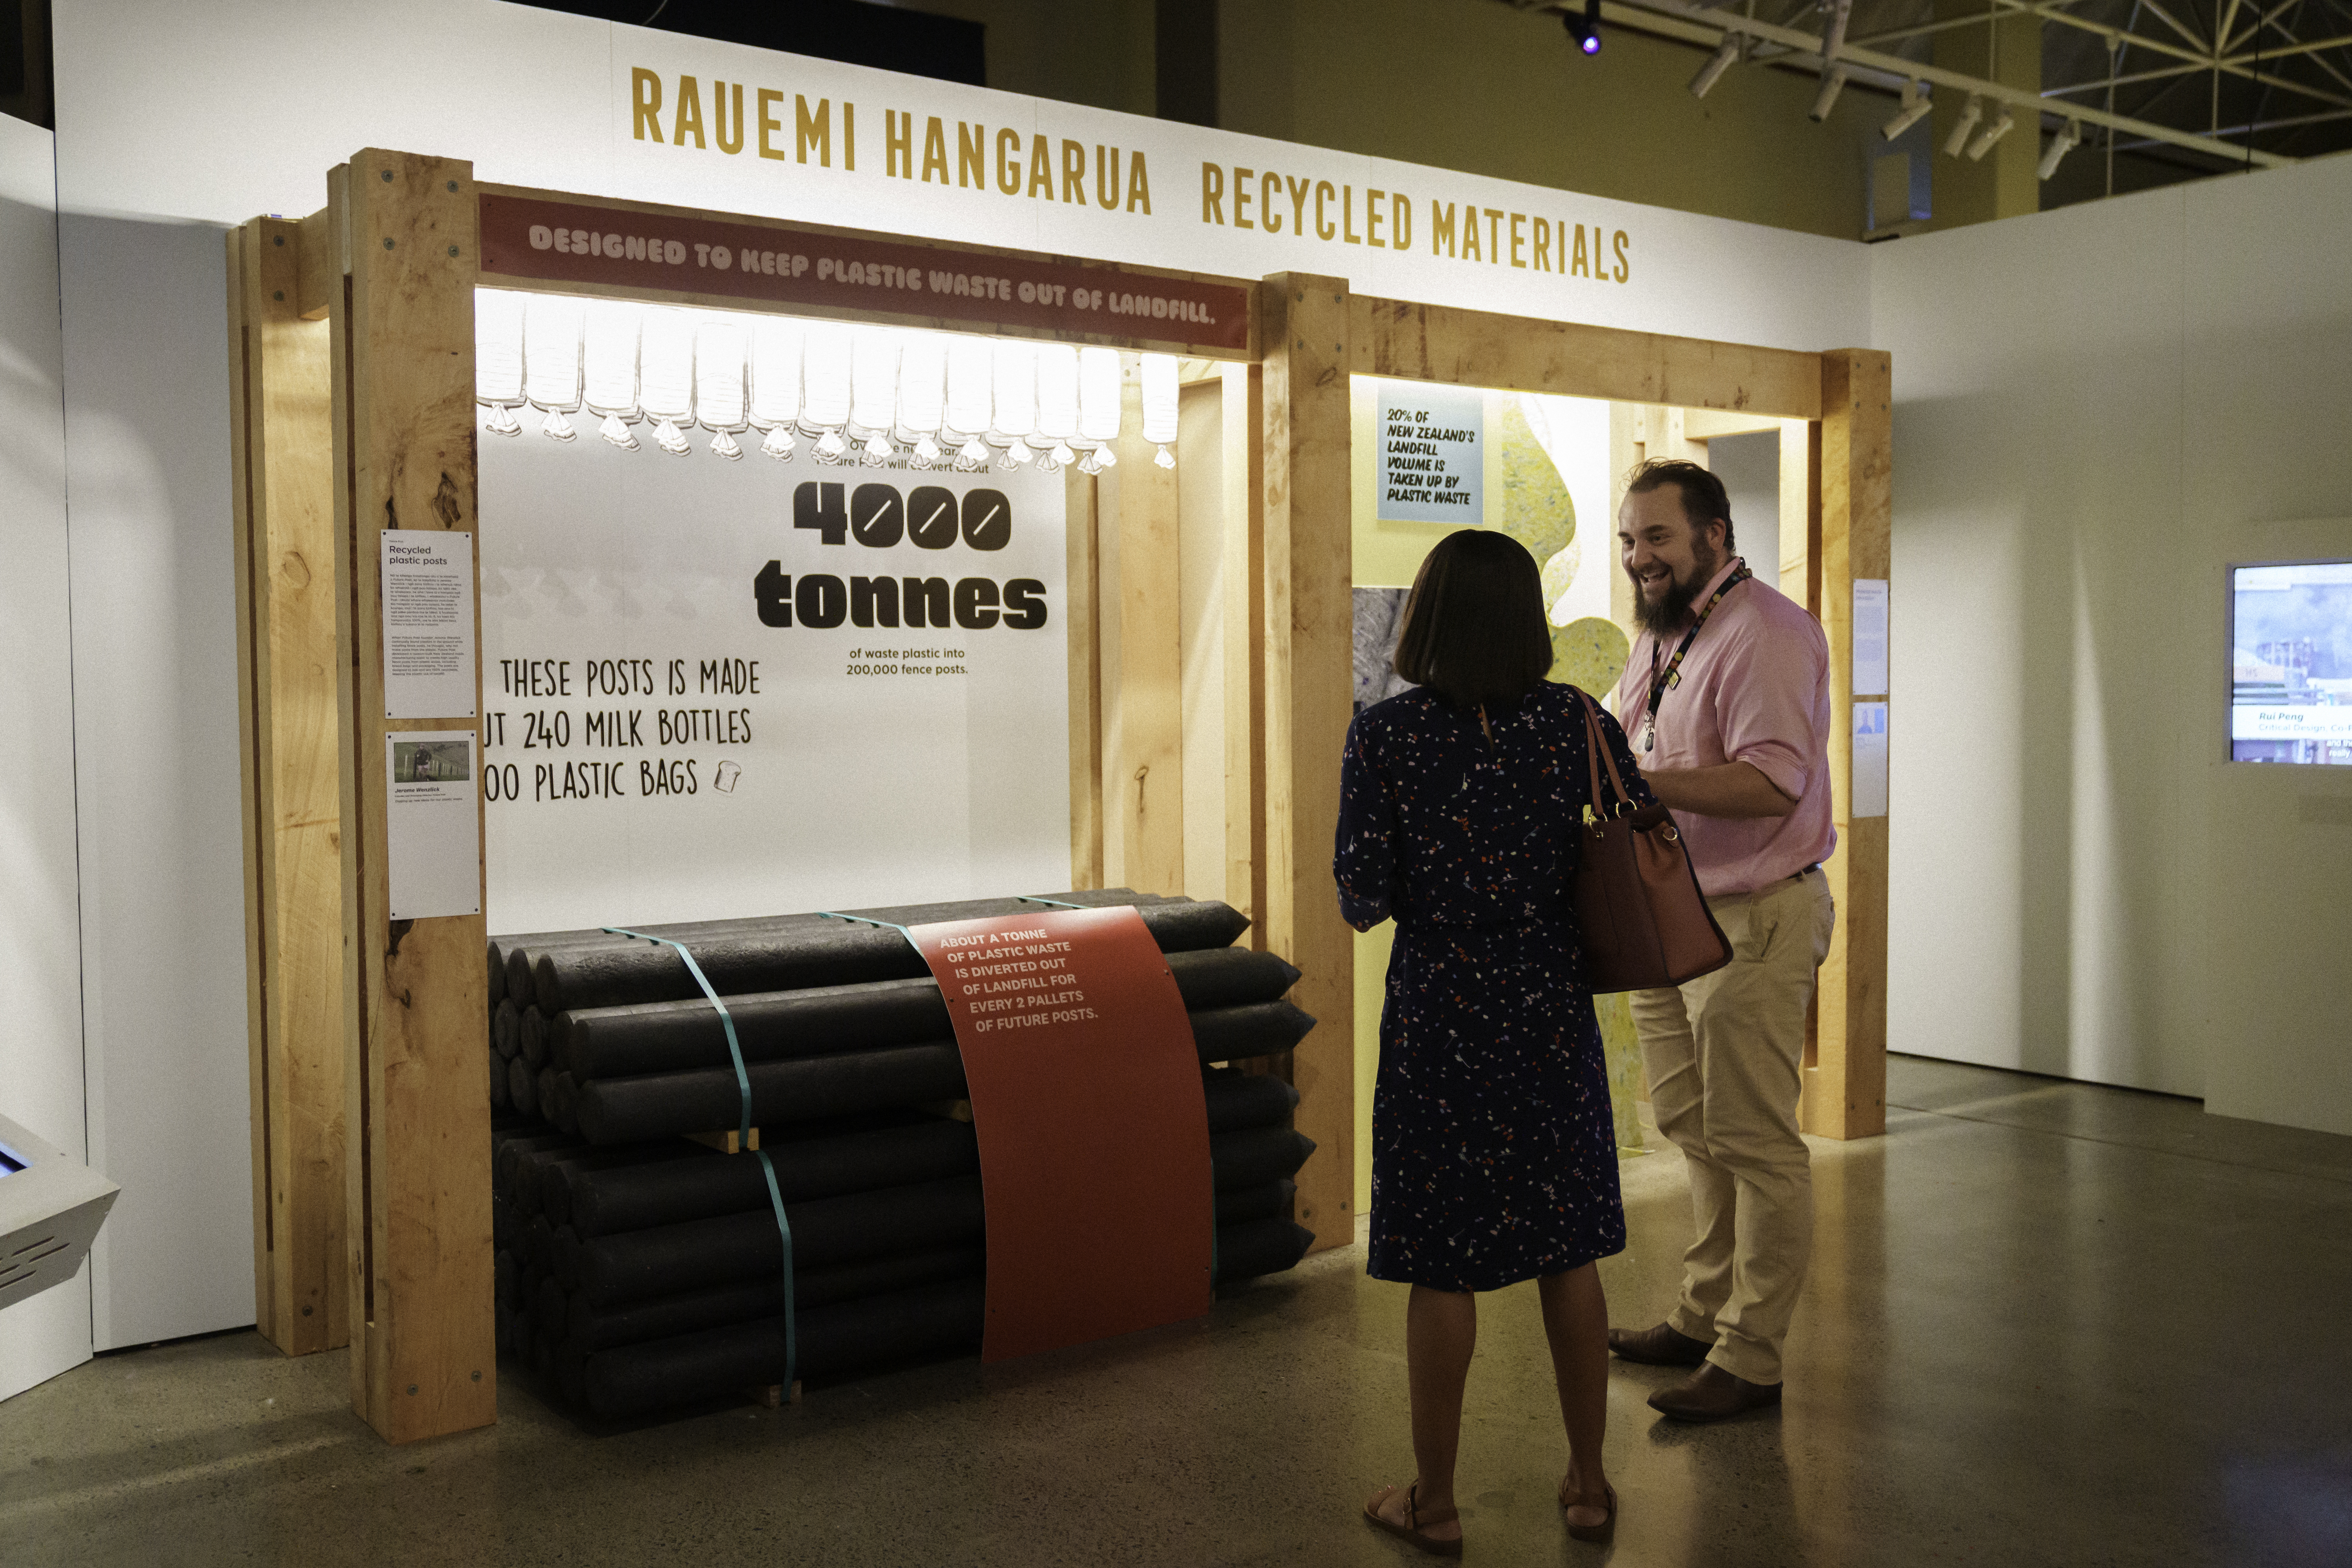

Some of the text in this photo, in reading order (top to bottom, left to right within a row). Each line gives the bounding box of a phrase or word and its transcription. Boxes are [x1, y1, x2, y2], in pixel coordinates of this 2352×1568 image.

[632, 67, 1629, 283] RAUEMI HANGARUA RECYCLED MATERIALS
[529, 225, 1215, 324] DESIGNED TO KEEP PLASTIC WASTE OUT OF LANDFILL.
[1387, 408, 1429, 423] 20% OF
[1387, 425, 1474, 443] NEW ZEALAND'S
[1388, 441, 1437, 456] LANDFILL
[888, 459, 907, 469] will
[1388, 457, 1445, 472] VOLUME IS
[1388, 473, 1459, 488] TAKEN UP BY
[1387, 488, 1470, 505] PLASTIC WASTE
[793, 482, 1011, 551] 4000
[390, 546, 431, 555] Recycled
[390, 556, 420, 564] plastic
[754, 560, 1047, 630] tonnes
[849, 648, 965, 660] of waste plastic into
[500, 658, 760, 697] THESE POSTS IS MADE
[847, 664, 968, 676] 200,000 fence posts.
[2279, 713, 2303, 722] Peng
[524, 711, 570, 749] 240
[586, 710, 643, 747] MILK
[659, 708, 751, 745] BOTTLES
[536, 761, 624, 802] PLASTIC
[640, 759, 697, 796] BAGS
[940, 928, 1047, 948] ABOUT A TONNE
[947, 942, 1071, 962] OF PLASTIC WASTE
[955, 958, 1065, 978] IS DIVERTED OUT
[963, 974, 1076, 995] OF LANDFILL FOR
[970, 991, 1083, 1013] EVERY 2 PALLETS
[976, 1008, 1098, 1032] OF FUTURE POSTS.
